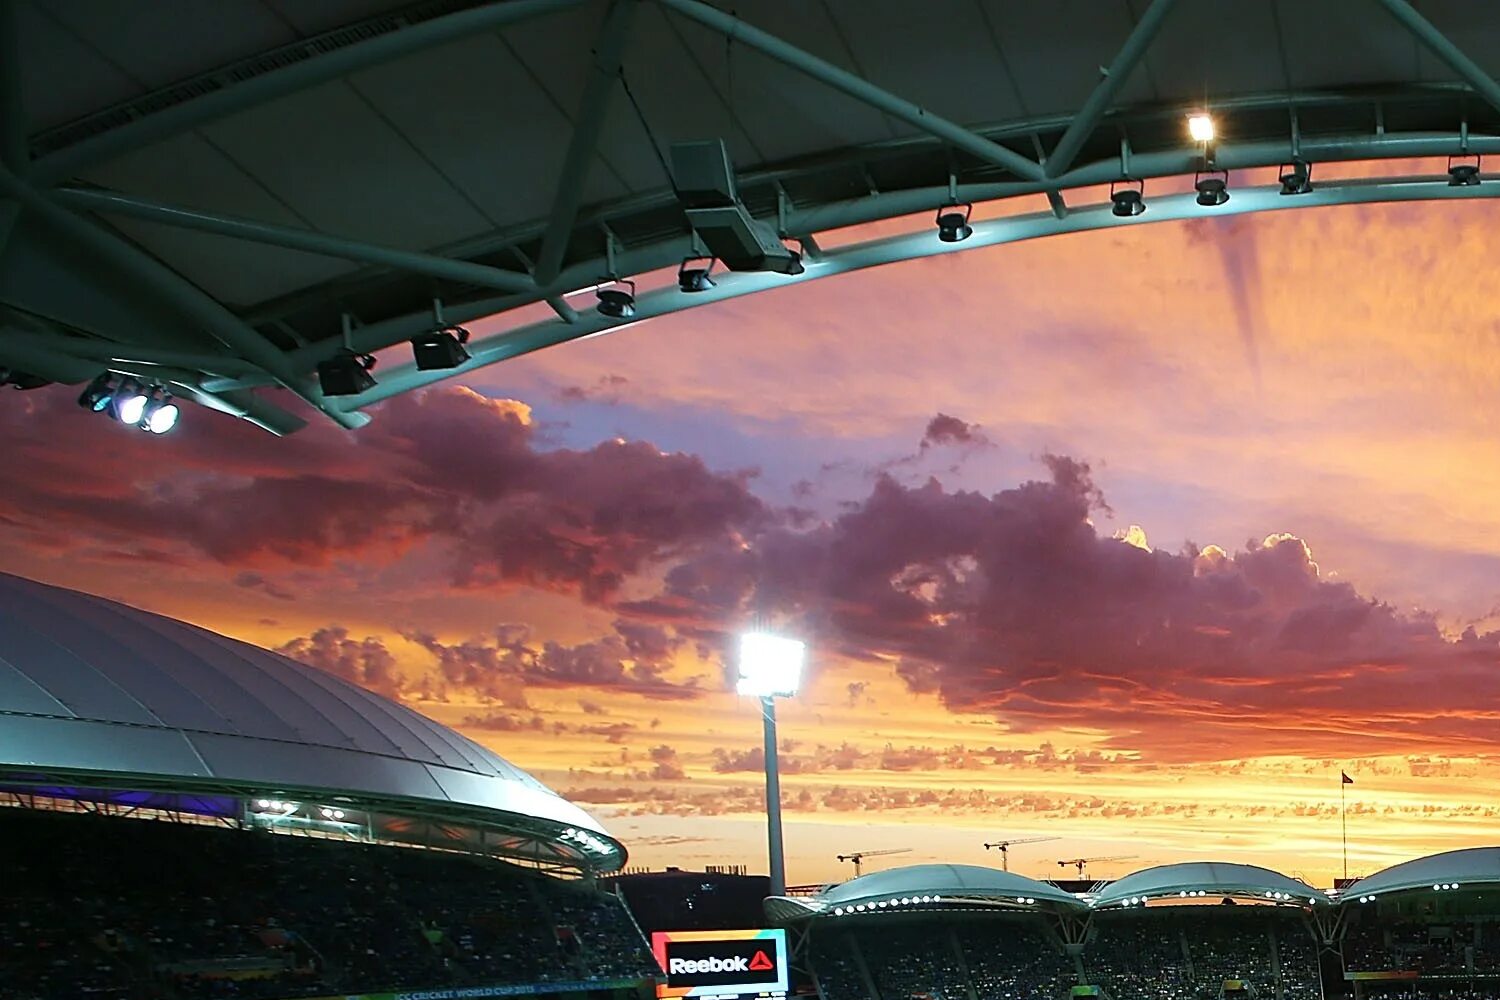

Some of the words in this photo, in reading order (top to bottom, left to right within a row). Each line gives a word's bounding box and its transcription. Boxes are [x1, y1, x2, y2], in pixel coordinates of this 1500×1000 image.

[669, 955, 749, 974] Reebok
[412, 990, 454, 1000] CRICKET
[455, 988, 492, 998] WORLD
[493, 986, 511, 995] CUP
